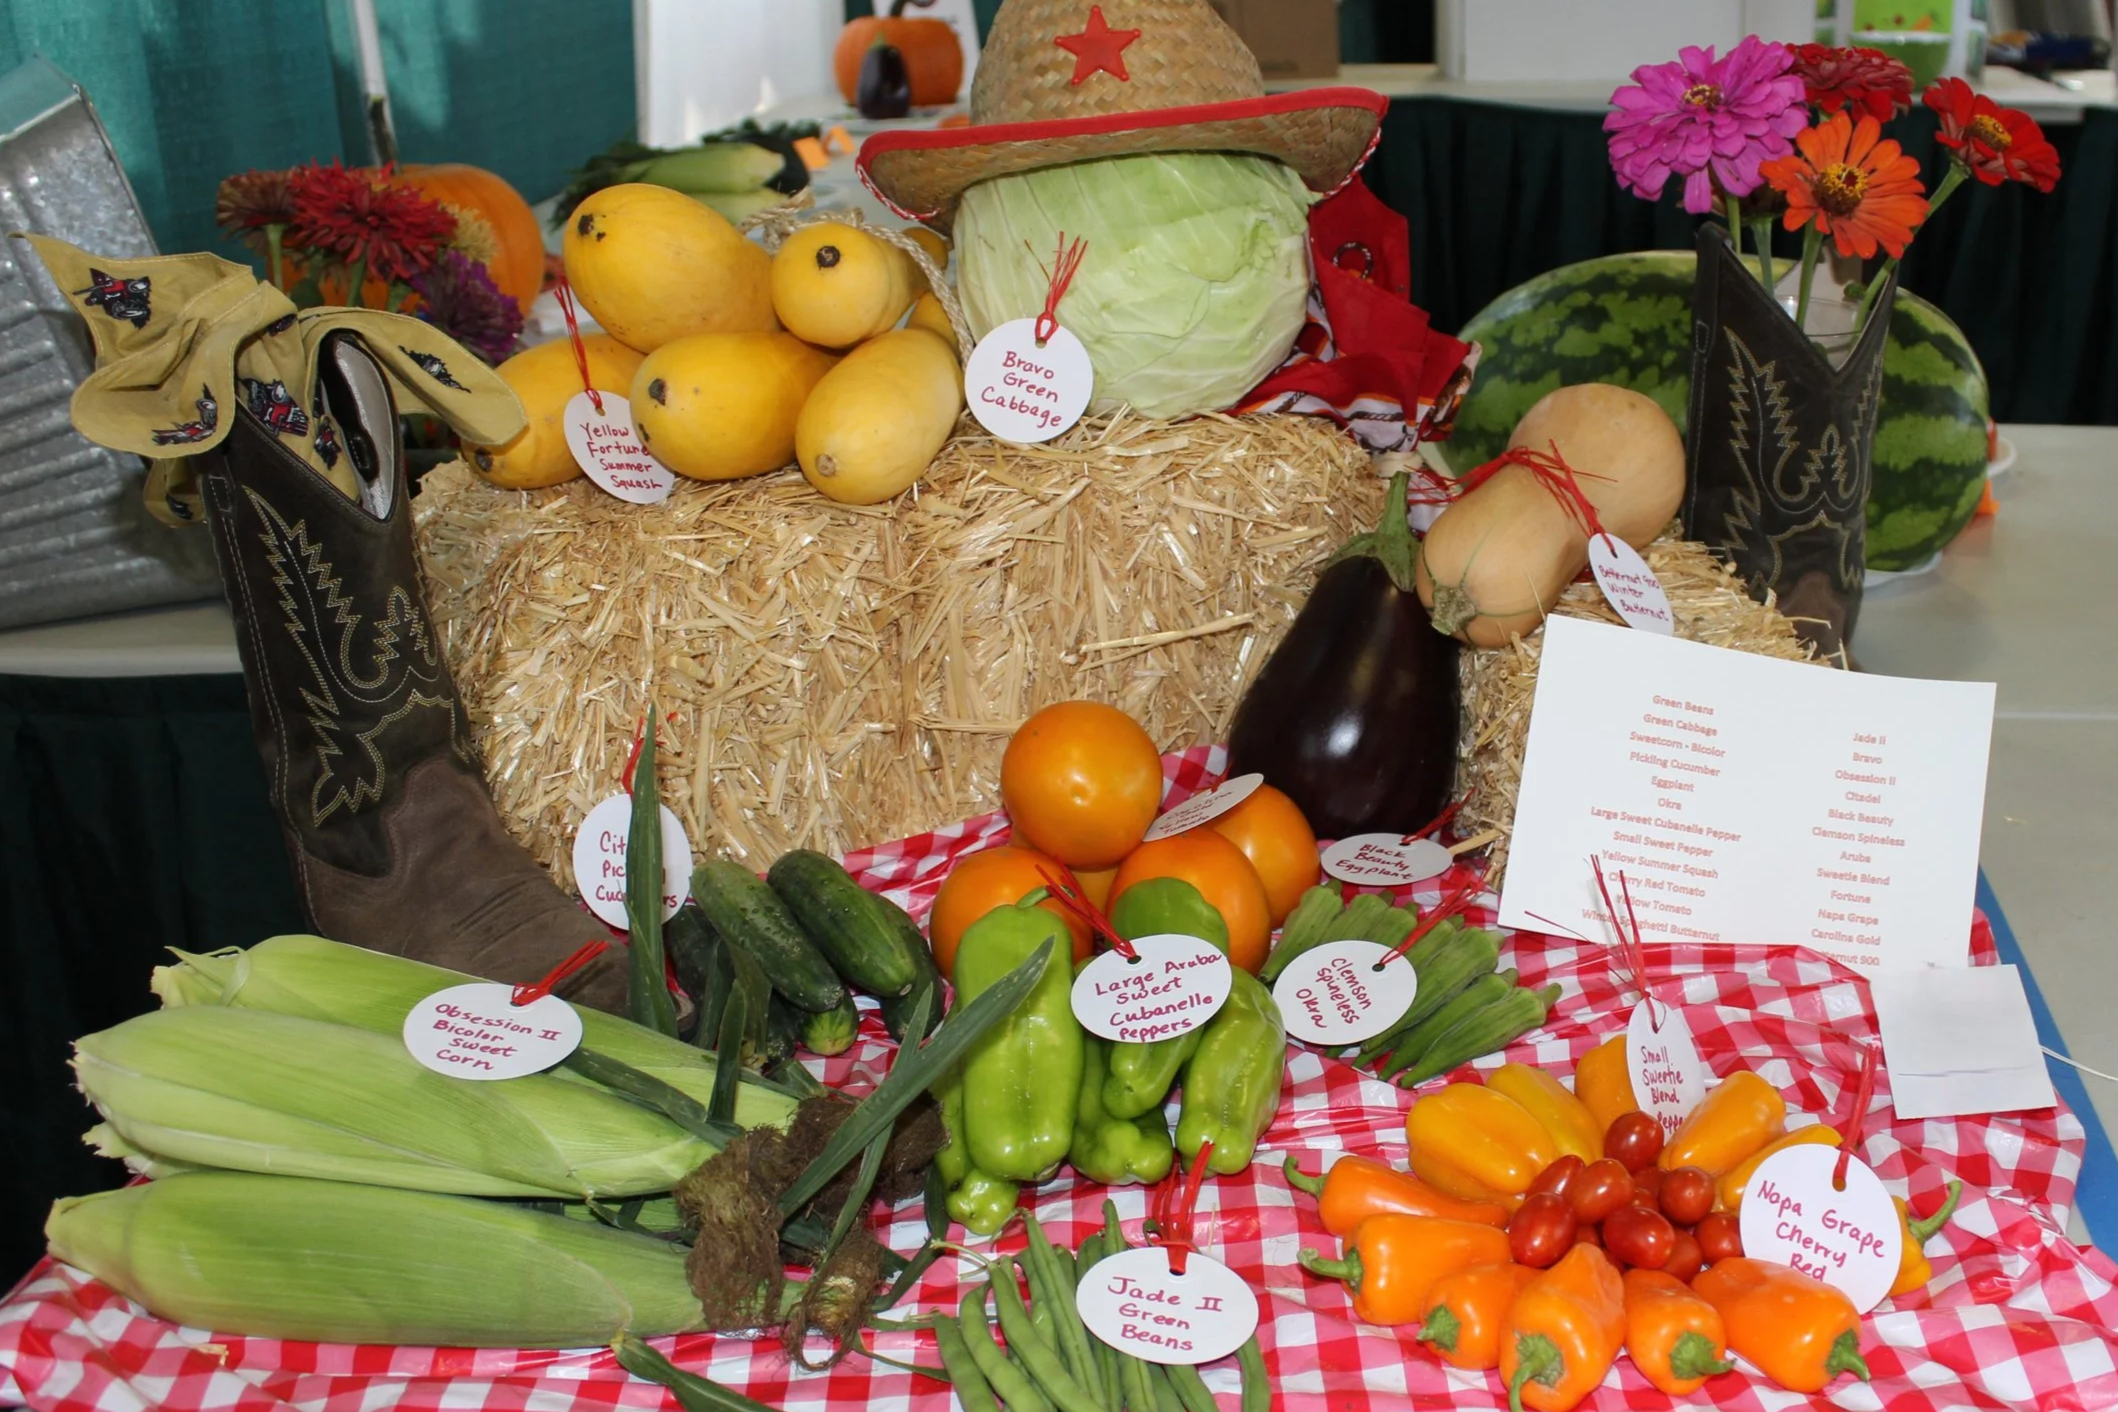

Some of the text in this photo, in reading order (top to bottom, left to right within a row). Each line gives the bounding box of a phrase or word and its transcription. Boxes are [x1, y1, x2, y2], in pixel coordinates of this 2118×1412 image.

[1002, 350, 1054, 379] Bravo
[1003, 372, 1058, 403] Green
[981, 386, 1062, 429] Cabbage
[579, 422, 629, 441] Yellow
[586, 441, 651, 458] Fortune
[599, 458, 652, 473] Summer
[610, 475, 663, 491] Squash
[1653, 695, 1714, 715] Green Beans
[1643, 713, 1718, 737] Green Cabbage
[1629, 731, 1683, 749] Sweetcorn
[1691, 742, 1726, 758] Bicolor
[1853, 733, 1877, 744] Jade
[1629, 751, 1721, 777] Pickling Cucumber
[1852, 752, 1883, 764] Bravo
[1651, 776, 1695, 792] Eggplant
[1835, 769, 1887, 785] Obsession
[1657, 797, 1682, 811] Okra
[1845, 791, 1881, 804] Citadel
[1590, 806, 1742, 842] Large Sweet Cubanelle Pepper
[1828, 808, 1895, 827] Black Beauty
[1613, 830, 1714, 857] Small Sweet Pepper
[1812, 826, 1905, 847] Clemson Spineless
[1359, 843, 1406, 858] Black
[1840, 851, 1872, 863] Aruba
[1354, 852, 1410, 872] Beauty
[1602, 849, 1719, 879] Yellow Summer Squash
[1817, 867, 1891, 886] Sweetie Blend
[1644, 878, 1666, 891] Red
[1666, 882, 1706, 898] Tomato
[1830, 890, 1872, 904] Fortune
[1653, 900, 1692, 916] Tomato
[1818, 909, 1880, 926] Napa Grape
[1582, 908, 1720, 941] Winte Spghetti Butternut
[1811, 928, 1882, 946] Carolina Gold
[1095, 954, 1223, 996] Large Aruba
[1331, 958, 1372, 1010] Clemson
[1295, 988, 1328, 1029] Okra
[433, 1019, 505, 1042] Bicolor
[435, 1003, 563, 1041] Obsession II
[436, 1049, 494, 1071] Corn
[1640, 1045, 1669, 1064] Small
[1642, 1064, 1684, 1087] Sweetie
[1650, 1087, 1680, 1105] Blend
[1657, 1111, 1683, 1134] Peppe
[1757, 1180, 1885, 1259] Napa Grape
[1775, 1221, 1847, 1268] Cherry
[1790, 1253, 1827, 1283] Red
[1107, 1275, 1224, 1313] Jade II
[1118, 1302, 1191, 1331] Green
[1120, 1323, 1194, 1351] Beans
